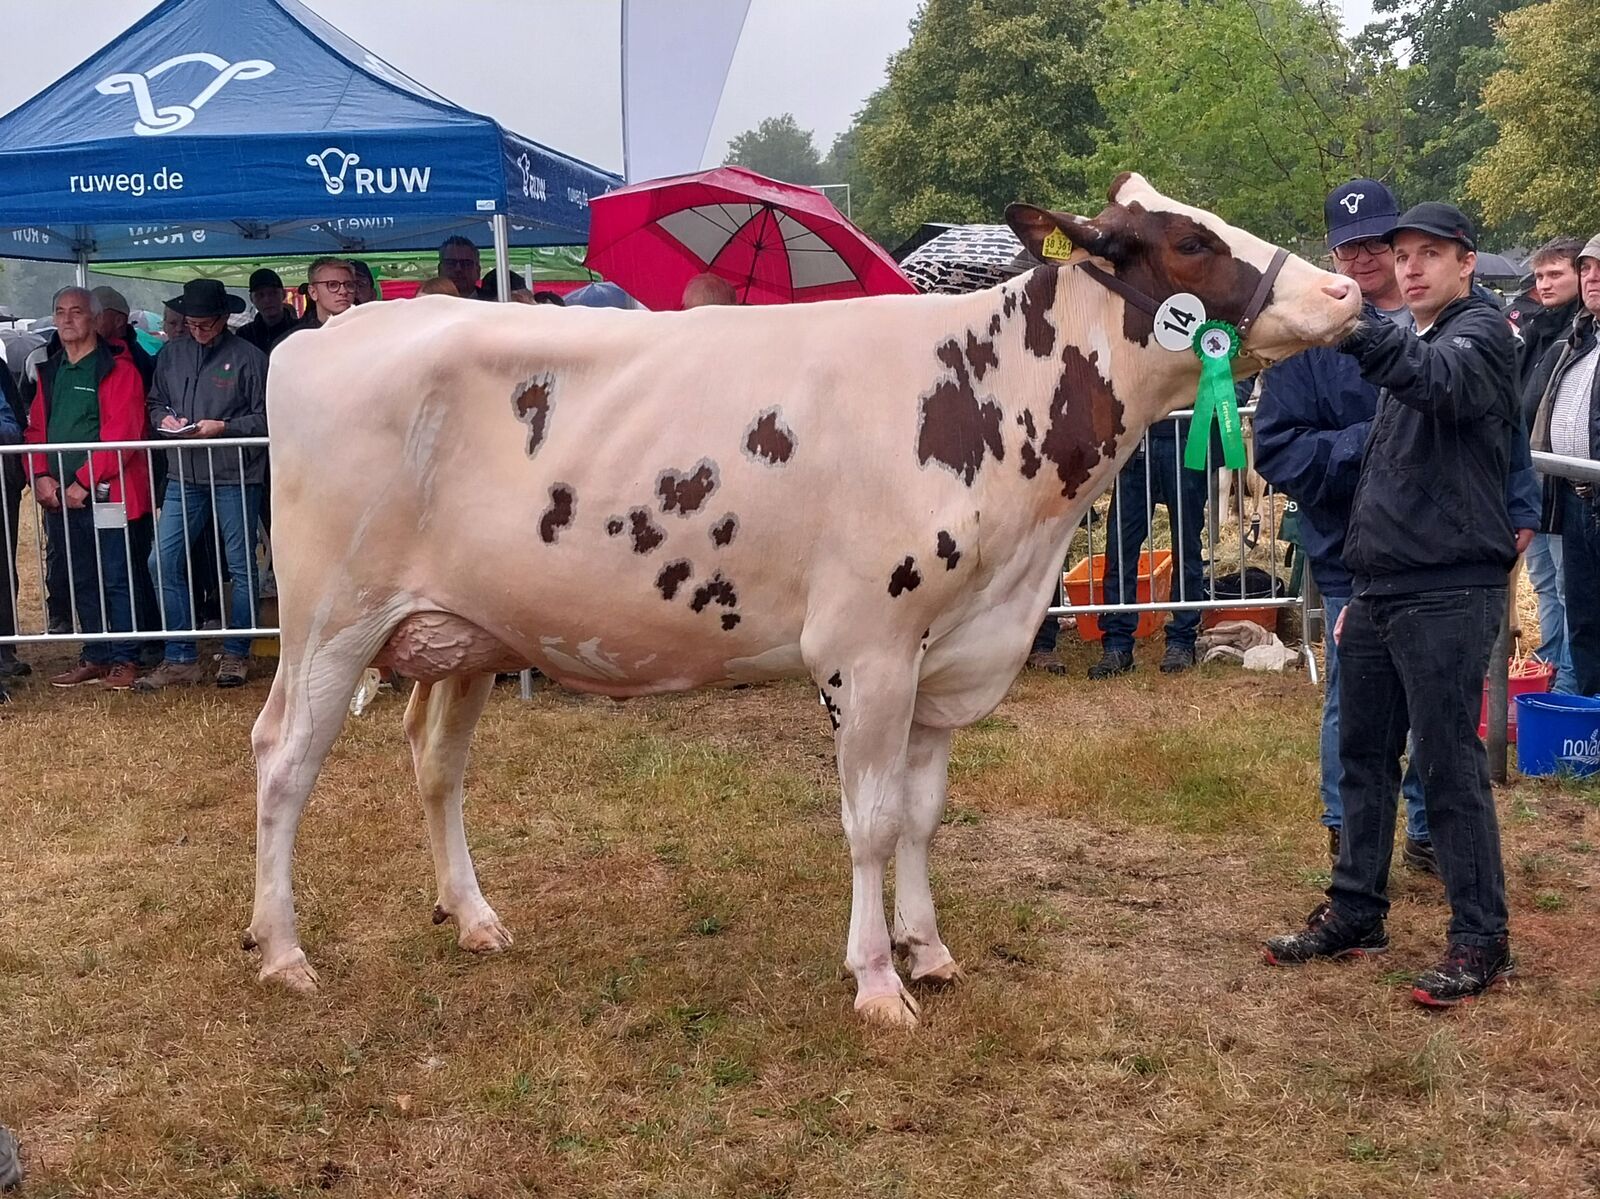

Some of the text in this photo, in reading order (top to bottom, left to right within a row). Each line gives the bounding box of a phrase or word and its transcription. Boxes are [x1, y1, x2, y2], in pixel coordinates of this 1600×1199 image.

[70, 166, 183, 196] ruweg.de
[355, 166, 431, 194] RUW
[529, 174, 546, 202] RUW
[1045, 238, 1055, 249] 38
[1163, 306, 1197, 336] 14
